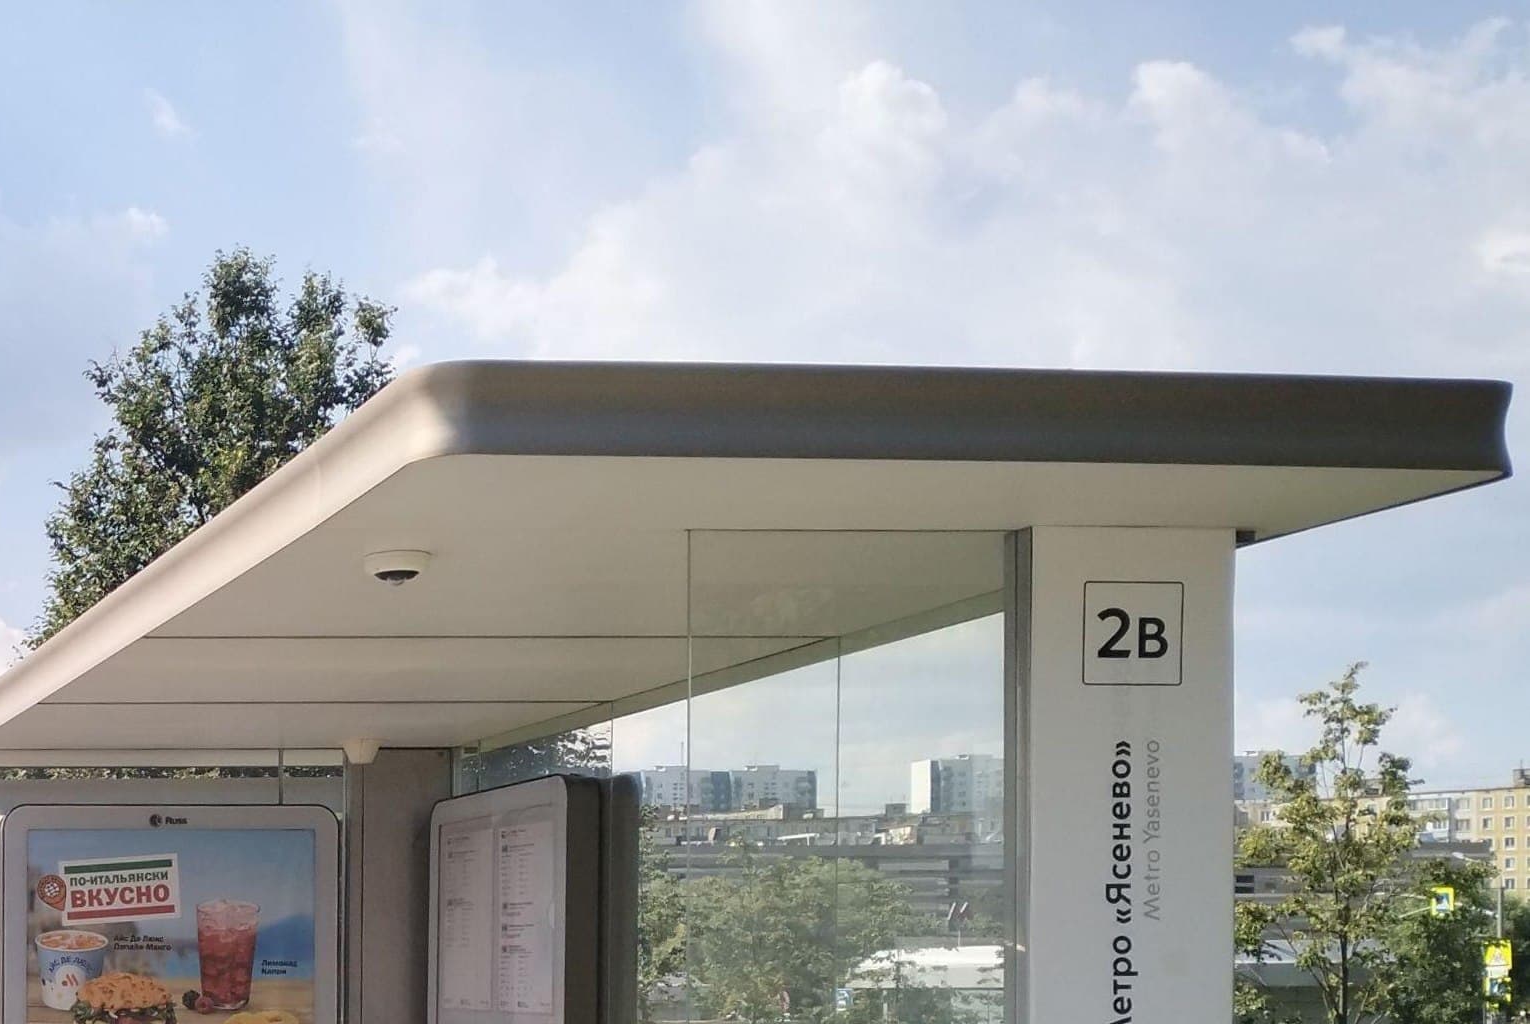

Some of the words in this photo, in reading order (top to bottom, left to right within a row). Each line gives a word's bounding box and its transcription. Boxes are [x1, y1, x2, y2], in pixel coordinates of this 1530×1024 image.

[1097, 607, 1168, 659] 2В
[1143, 739, 1161, 842] Yasenevo
[1105, 740, 1133, 924] «Ясенево»
[70, 871, 168, 887] ПО-ИТАЛЬЯНСКИ
[71, 884, 170, 908] ВКУСНО
[1143, 850, 1161, 921] Metro
